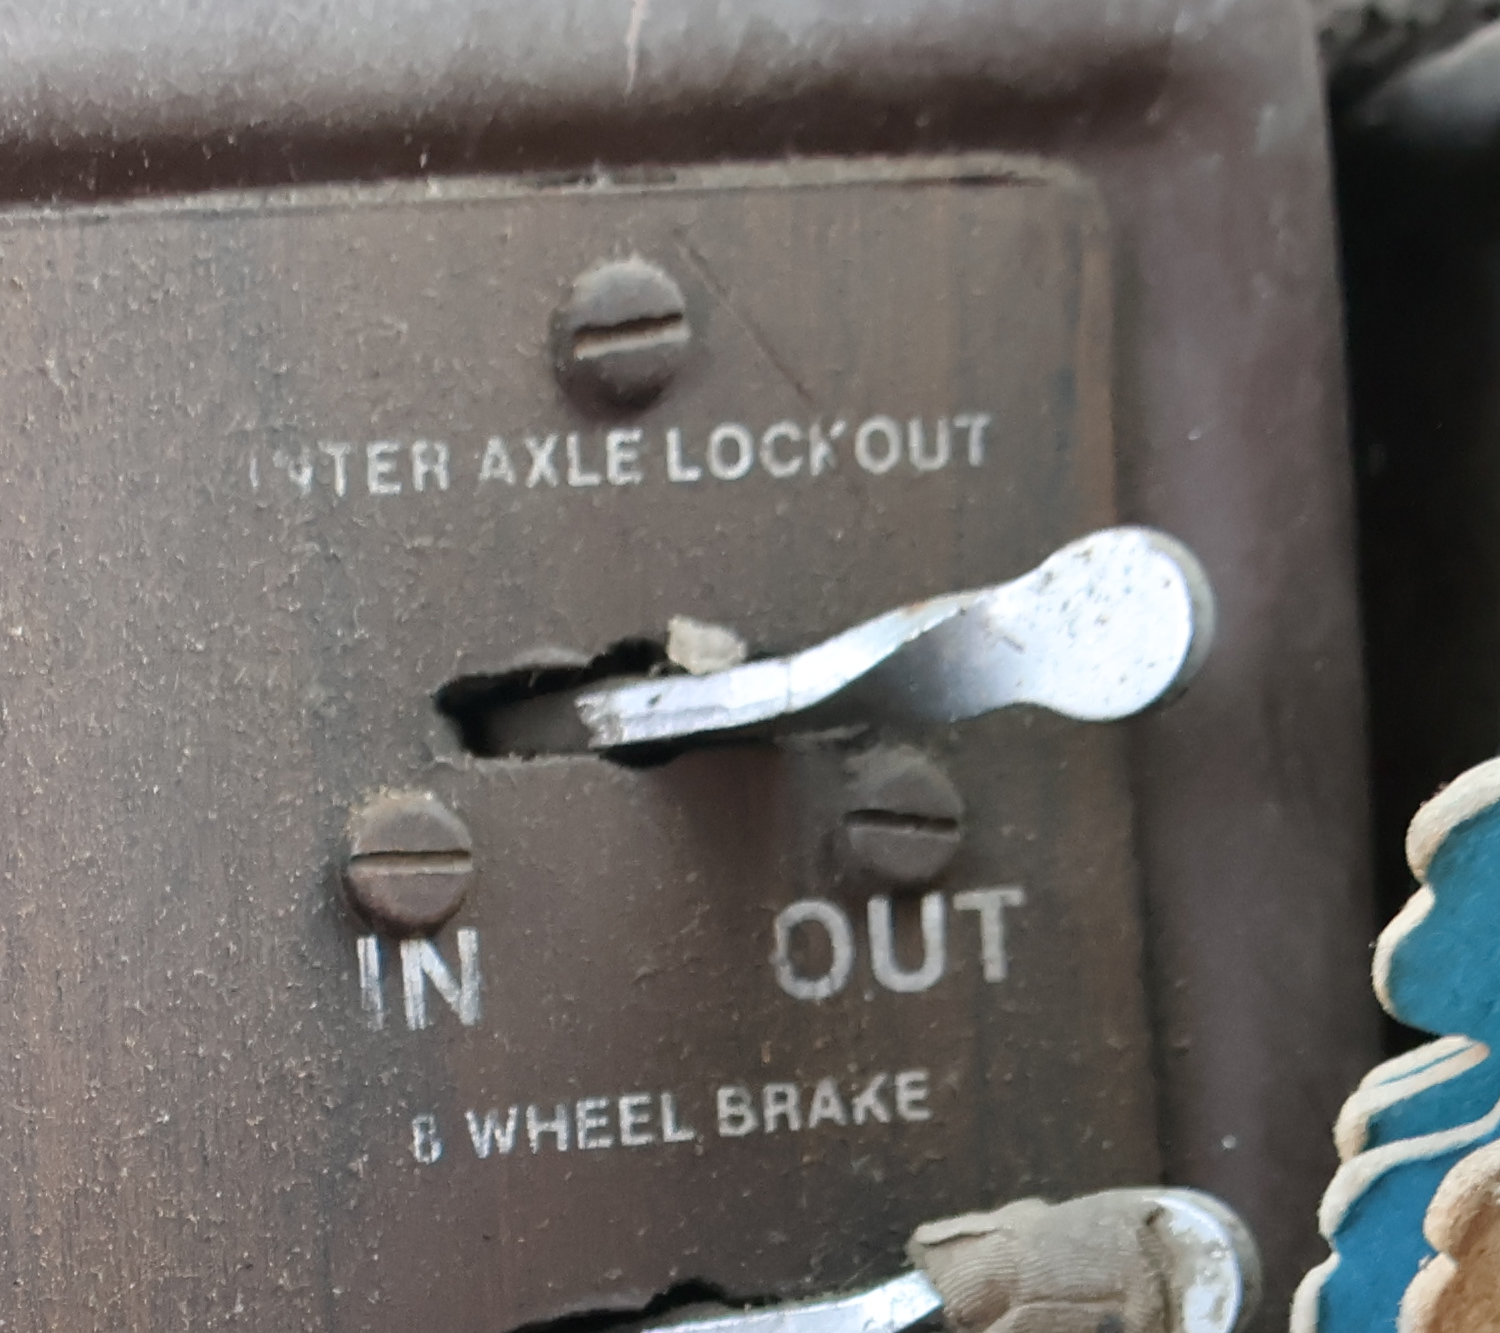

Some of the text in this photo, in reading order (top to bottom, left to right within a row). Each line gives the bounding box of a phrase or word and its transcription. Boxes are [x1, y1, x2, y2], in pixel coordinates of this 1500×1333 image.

[479, 426, 643, 490] AXLE
[666, 414, 993, 482] LOCKOUT
[356, 888, 1025, 1030] IN OUT
[466, 1091, 697, 1160] WHEEL
[716, 1070, 934, 1137] BRAKE
